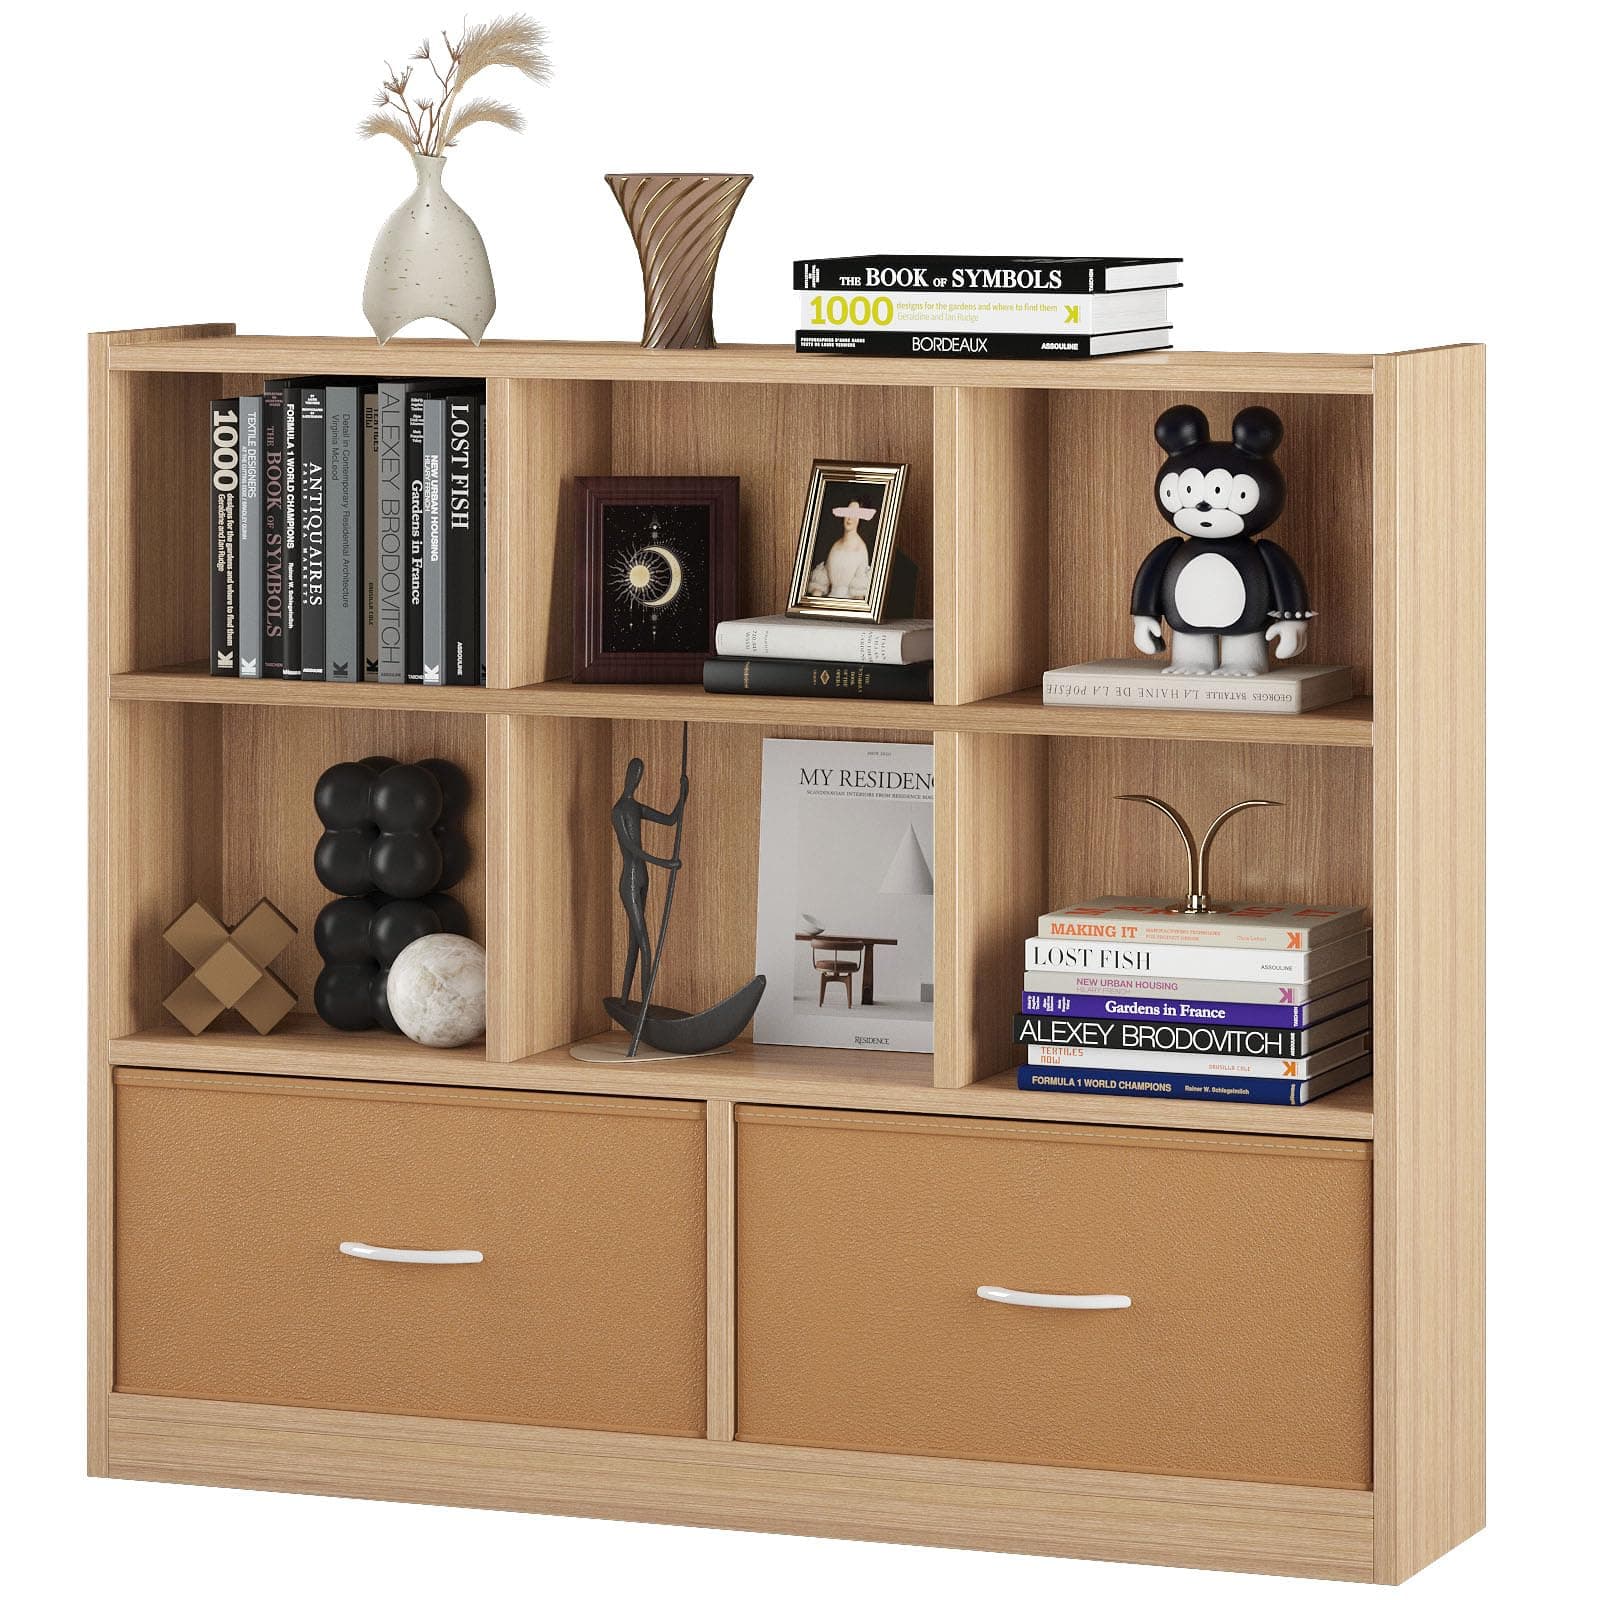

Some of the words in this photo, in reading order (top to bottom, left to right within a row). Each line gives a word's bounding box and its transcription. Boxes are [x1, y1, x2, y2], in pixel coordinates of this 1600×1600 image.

[839, 276, 861, 286] THE
[865, 267, 930, 287] BOOK
[933, 278, 948, 287] OF
[951, 268, 1062, 289] SYMBOLS
[810, 295, 894, 326] 1000
[896, 302, 924, 312] designs
[925, 301, 935, 311] for
[936, 302, 947, 311] the
[948, 302, 977, 313] gardens
[978, 303, 991, 312] and
[992, 303, 1014, 312] where
[1015, 304, 1023, 312] to
[1024, 303, 1038, 312] find
[1039, 303, 1058, 313] them
[912, 337, 988, 352] BORDEAUX
[1041, 342, 1079, 351] ASSOULINE
[247, 412, 257, 447] TEXTILE
[266, 426, 275, 447] THE
[286, 403, 295, 449] FORMULA
[331, 414, 340, 445] Virginia
[342, 413, 351, 438] Detail
[450, 403, 469, 468] LOST
[213, 409, 239, 492] 1000
[342, 439, 351, 447] in
[381, 391, 401, 491] ALEXEY
[247, 449, 257, 498] DESIGNERS
[286, 456, 295, 492] WORLD
[332, 447, 340, 481] McLeod
[430, 455, 439, 478] NEW
[266, 451, 283, 511] BOOK
[340, 449, 351, 508] Contemporary
[225, 493, 235, 519] designs
[430, 479, 439, 514] URBAN
[450, 472, 469, 530] FISH
[217, 494, 226, 525] Geraldine
[411, 479, 423, 537] Gardens
[217, 525, 226, 538] and
[226, 519, 235, 530] for
[266, 515, 275, 529] OF
[286, 493, 295, 549] CHAMPIONS
[226, 531, 235, 541] the
[308, 462, 323, 606] ANTIQUAIRES
[342, 510, 351, 556] Residential
[430, 516, 439, 562] HOUSING
[224, 542, 235, 570] gardens
[411, 540, 423, 554] in
[216, 551, 226, 572] Rudge
[226, 570, 235, 583] and
[266, 533, 283, 638] SYMBOLS
[342, 558, 351, 608] Architecture
[381, 499, 401, 664] BRODOVITCH
[411, 558, 423, 605] France
[226, 584, 235, 605] where
[226, 606, 235, 614] to
[226, 614, 235, 628] find
[226, 628, 235, 646] them
[1092, 685, 1109, 697] LA
[1114, 686, 1132, 697] DE
[1137, 687, 1179, 699] HAINE
[1183, 689, 1200, 700] LA
[1205, 691, 1247, 701] BATAILLE
[1252, 692, 1293, 702] GEORGES
[800, 767, 834, 786] MY
[1050, 922, 1117, 938] MAKING
[1121, 926, 1138, 939] IT
[1033, 946, 1093, 968] LOST
[1101, 950, 1152, 970] FISH
[1260, 964, 1293, 972] ASSOULINE
[1076, 978, 1102, 987] NEW
[1104, 979, 1133, 989] URBAN
[1135, 981, 1178, 991] HOUSING
[1105, 1000, 1161, 1016] Gardens
[1163, 1004, 1177, 1016] in
[1180, 1005, 1226, 1019] France
[854, 1036, 890, 1045] RESIDENCE
[1019, 1019, 1115, 1045] ALEXEY
[1122, 1024, 1282, 1056] BRODOVITCH
[1032, 1075, 1074, 1086] FORMULA
[1076, 1078, 1081, 1087] 1
[1084, 1078, 1117, 1089] WORLD
[1118, 1080, 1172, 1092] CHAMPIONS
